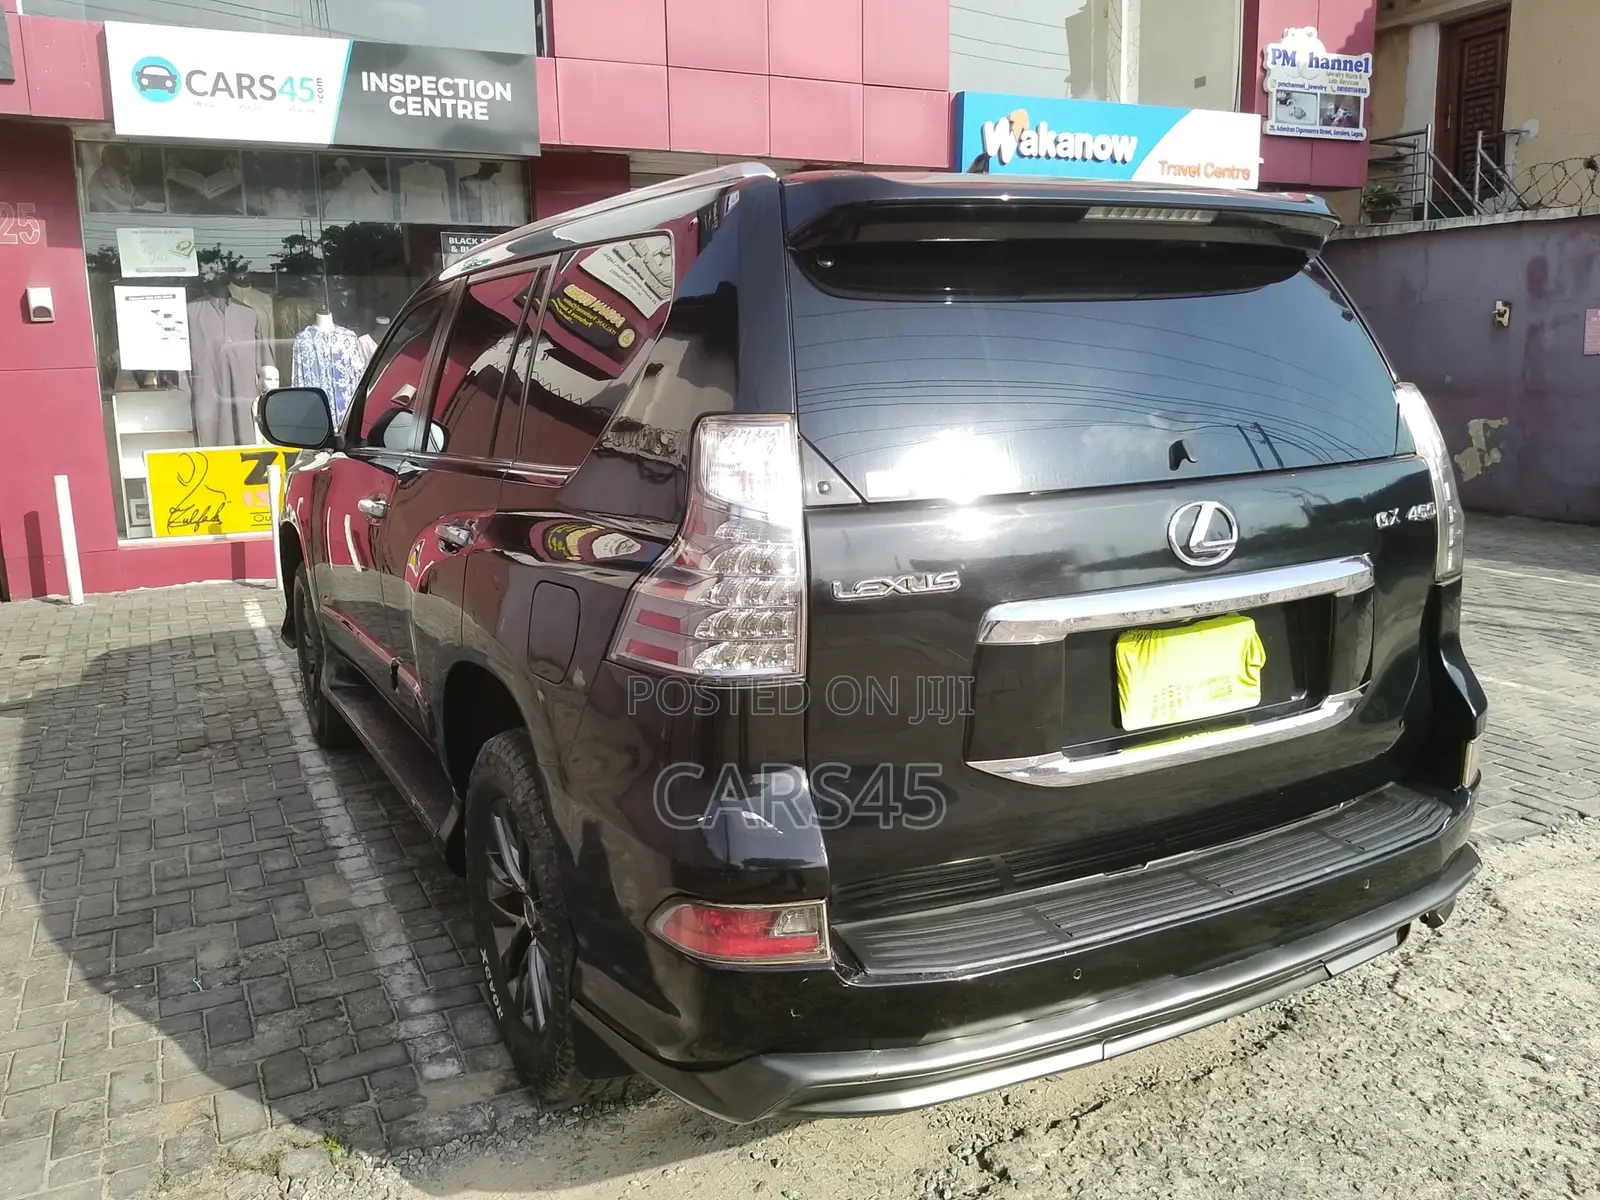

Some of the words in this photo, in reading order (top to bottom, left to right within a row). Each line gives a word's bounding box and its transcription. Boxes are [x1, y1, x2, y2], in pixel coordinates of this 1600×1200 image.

[1271, 48, 1297, 67] PM
[1300, 52, 1369, 74] hannel
[361, 71, 512, 102] INSPECTION
[388, 95, 490, 121] CENTRE
[983, 110, 1138, 166] Wakanow
[1159, 159, 1201, 178] Travel
[0, 202, 40, 244] 25
[448, 236, 478, 245] BLACK
[450, 245, 458, 253] &
[830, 570, 961, 602] LEXUS
[479, 947, 504, 1021] ROADX
